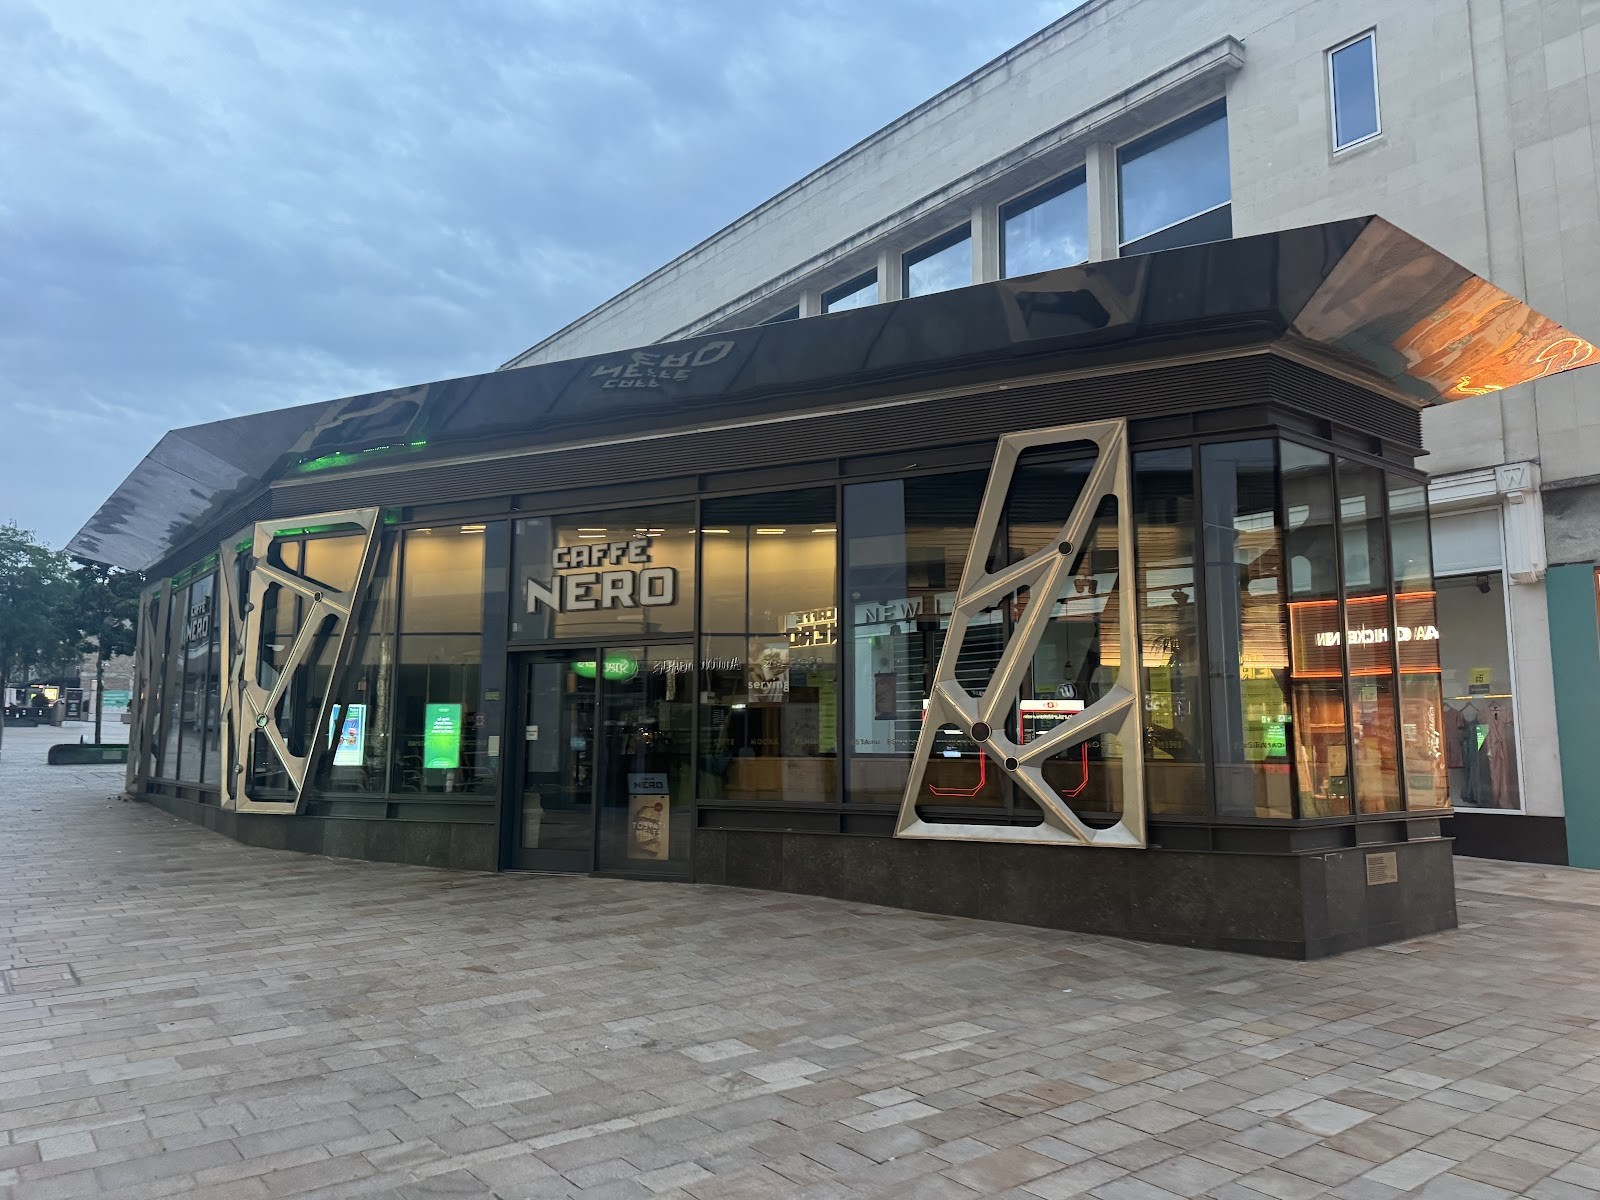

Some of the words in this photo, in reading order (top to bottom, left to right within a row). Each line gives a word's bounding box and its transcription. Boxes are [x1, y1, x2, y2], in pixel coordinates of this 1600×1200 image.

[527, 566, 677, 614] NERO
[186, 616, 209, 641] NERO
[748, 678, 790, 692] serving
[633, 781, 663, 789] NERO
